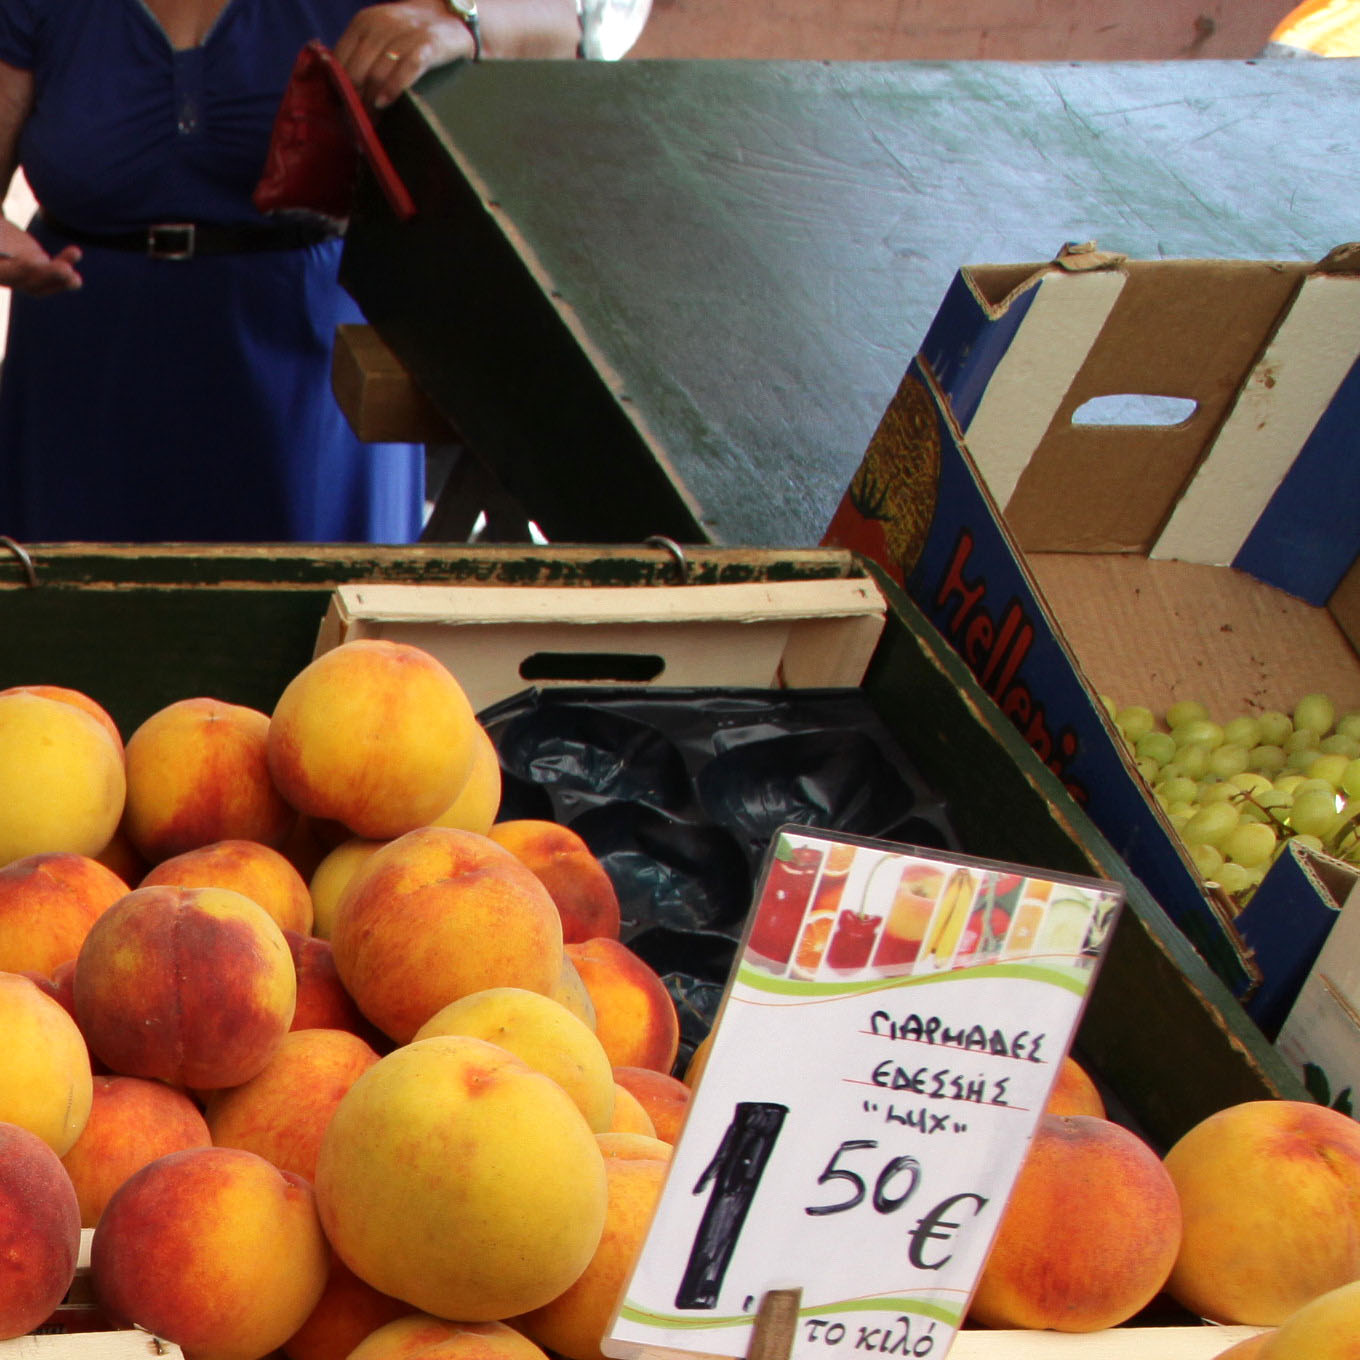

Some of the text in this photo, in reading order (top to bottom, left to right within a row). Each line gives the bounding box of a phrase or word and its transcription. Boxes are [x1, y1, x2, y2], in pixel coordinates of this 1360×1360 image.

[870, 1010, 1046, 1064] ΓΙΑΡΜΑΔΕΣ
[871, 1059, 1010, 1106] ΕΔΕΣΣΗΣ
[804, 1315, 937, 1358] το κιλό
